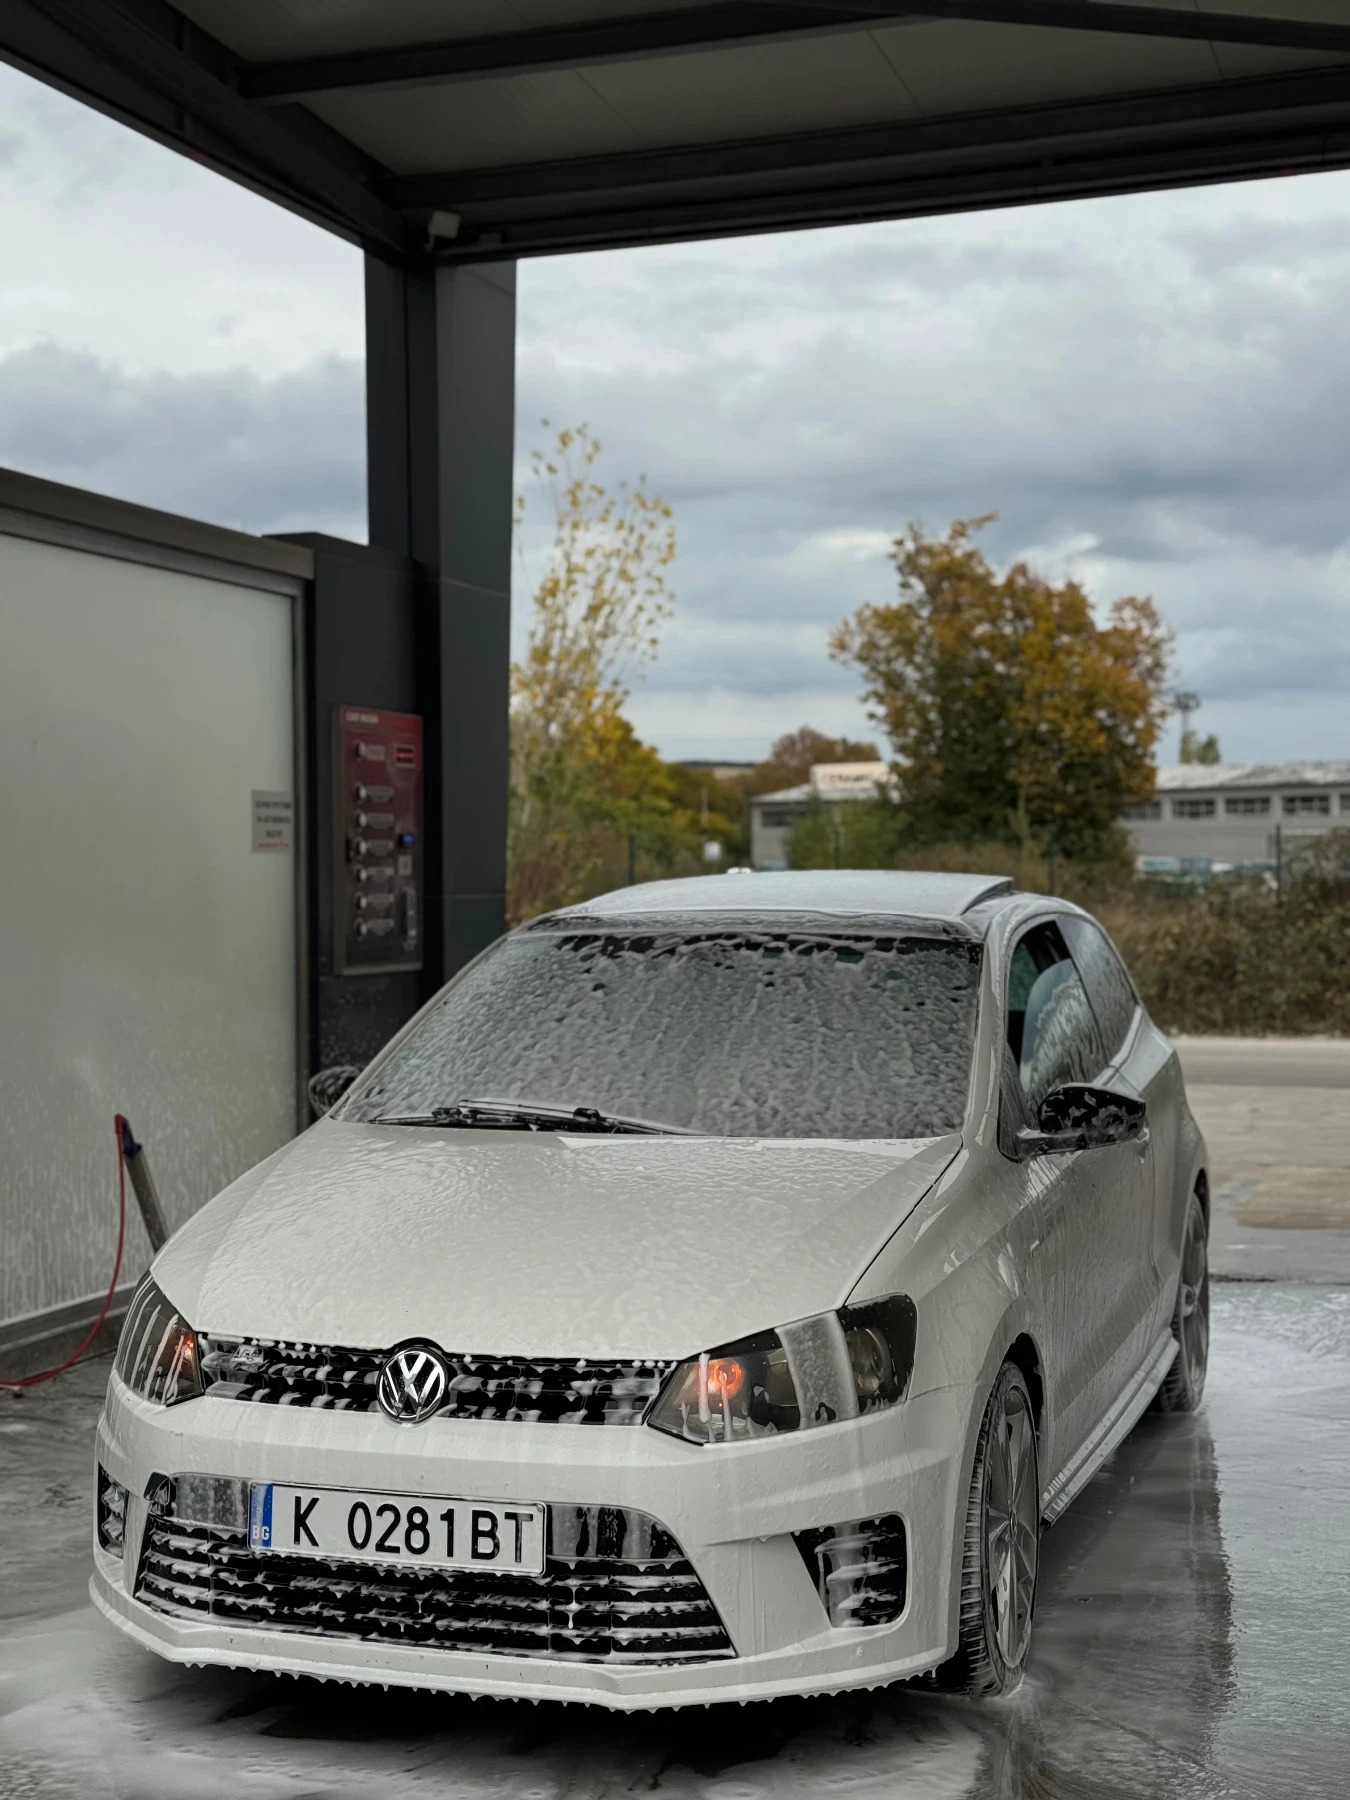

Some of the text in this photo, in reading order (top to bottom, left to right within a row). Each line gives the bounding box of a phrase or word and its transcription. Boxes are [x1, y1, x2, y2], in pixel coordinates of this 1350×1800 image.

[380, 1348, 446, 1420] VW
[251, 1525, 270, 1541] BG
[293, 1495, 320, 1547] K
